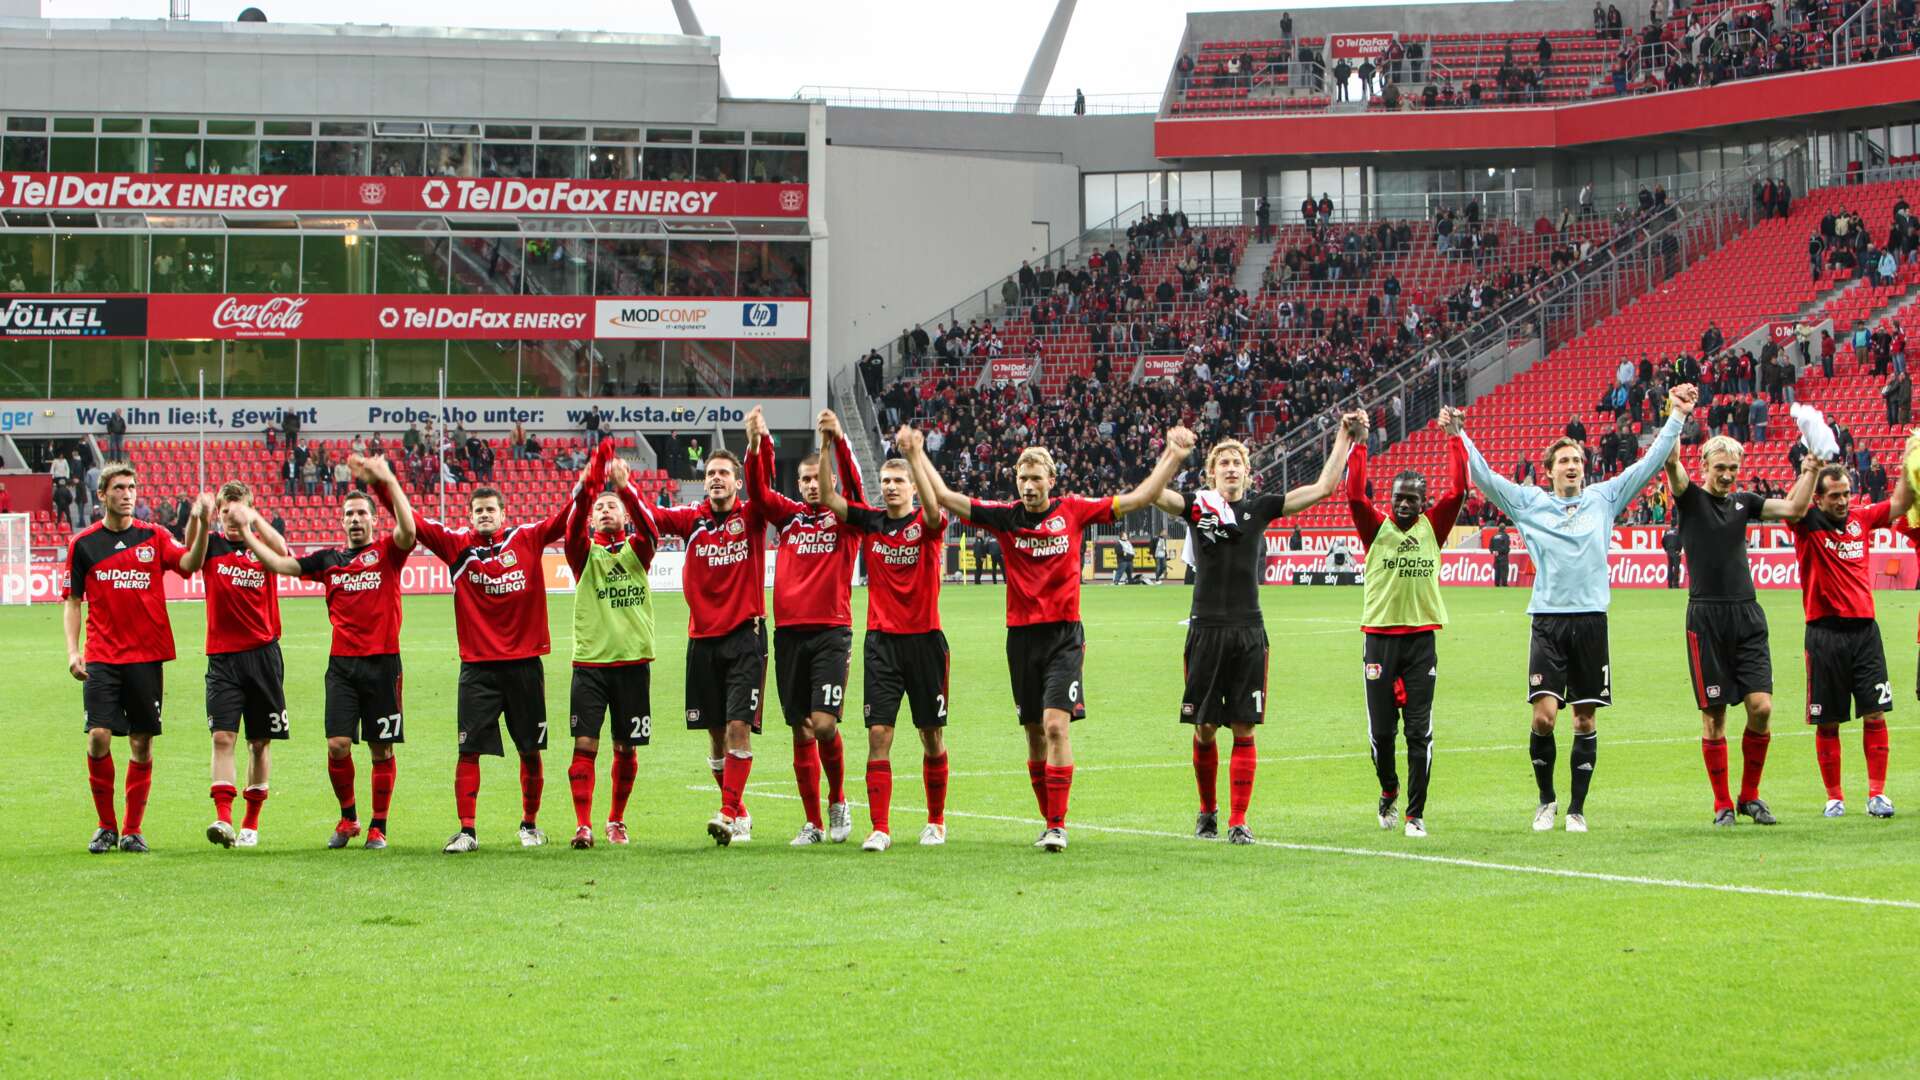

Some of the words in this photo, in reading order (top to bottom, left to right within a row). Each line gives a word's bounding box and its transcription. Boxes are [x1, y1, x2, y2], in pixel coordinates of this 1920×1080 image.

[11, 174, 174, 207] TelDaFax
[177, 184, 288, 208] ENERGY
[457, 180, 610, 212] TelDaFax
[614, 189, 718, 214] ENERGY
[403, 307, 511, 328] TelDaFax
[513, 313, 587, 329] ENERGY
[621, 308, 707, 323] MODCOMP
[752, 304, 768, 327] hp
[127, 407, 160, 425] ihn
[168, 407, 224, 428] liest,
[368, 406, 478, 424] Probe-Abo
[484, 406, 544, 423] unter:
[695, 539, 748, 557] TelDaFax
[796, 543, 836, 554] ENERG
[872, 541, 919, 556] TelDaFax
[1015, 534, 1069, 549] TelDaFax
[708, 551, 749, 567] ENERGY
[1032, 544, 1069, 557] ENERGY
[1382, 556, 1434, 569] TelDaFax
[95, 569, 151, 581] TelDaFax
[217, 563, 265, 580] TelDaFax
[330, 571, 382, 586] TelDaFax
[468, 569, 525, 585] TelDaFax
[1300, 573, 1313, 585] sky
[1325, 573, 1338, 585] sky
[1354, 573, 1364, 584] sk
[1399, 569, 1434, 577] ENERGY
[113, 580, 151, 589] ENERGY
[231, 577, 265, 588] ENERGY
[344, 580, 381, 592] ENERGY
[484, 580, 526, 595] ENERGY
[611, 596, 645, 608] ENERGY
[1602, 664, 1609, 686] 1
[750, 688, 759, 711] 5
[822, 683, 843, 706] 19
[1068, 680, 1079, 702] 6
[1875, 681, 1892, 704] 29
[936, 694, 946, 718] 2
[1252, 690, 1264, 713] 1
[269, 708, 289, 733] 39
[377, 713, 401, 740] 27
[630, 715, 651, 739] 28
[537, 721, 548, 744] 7
